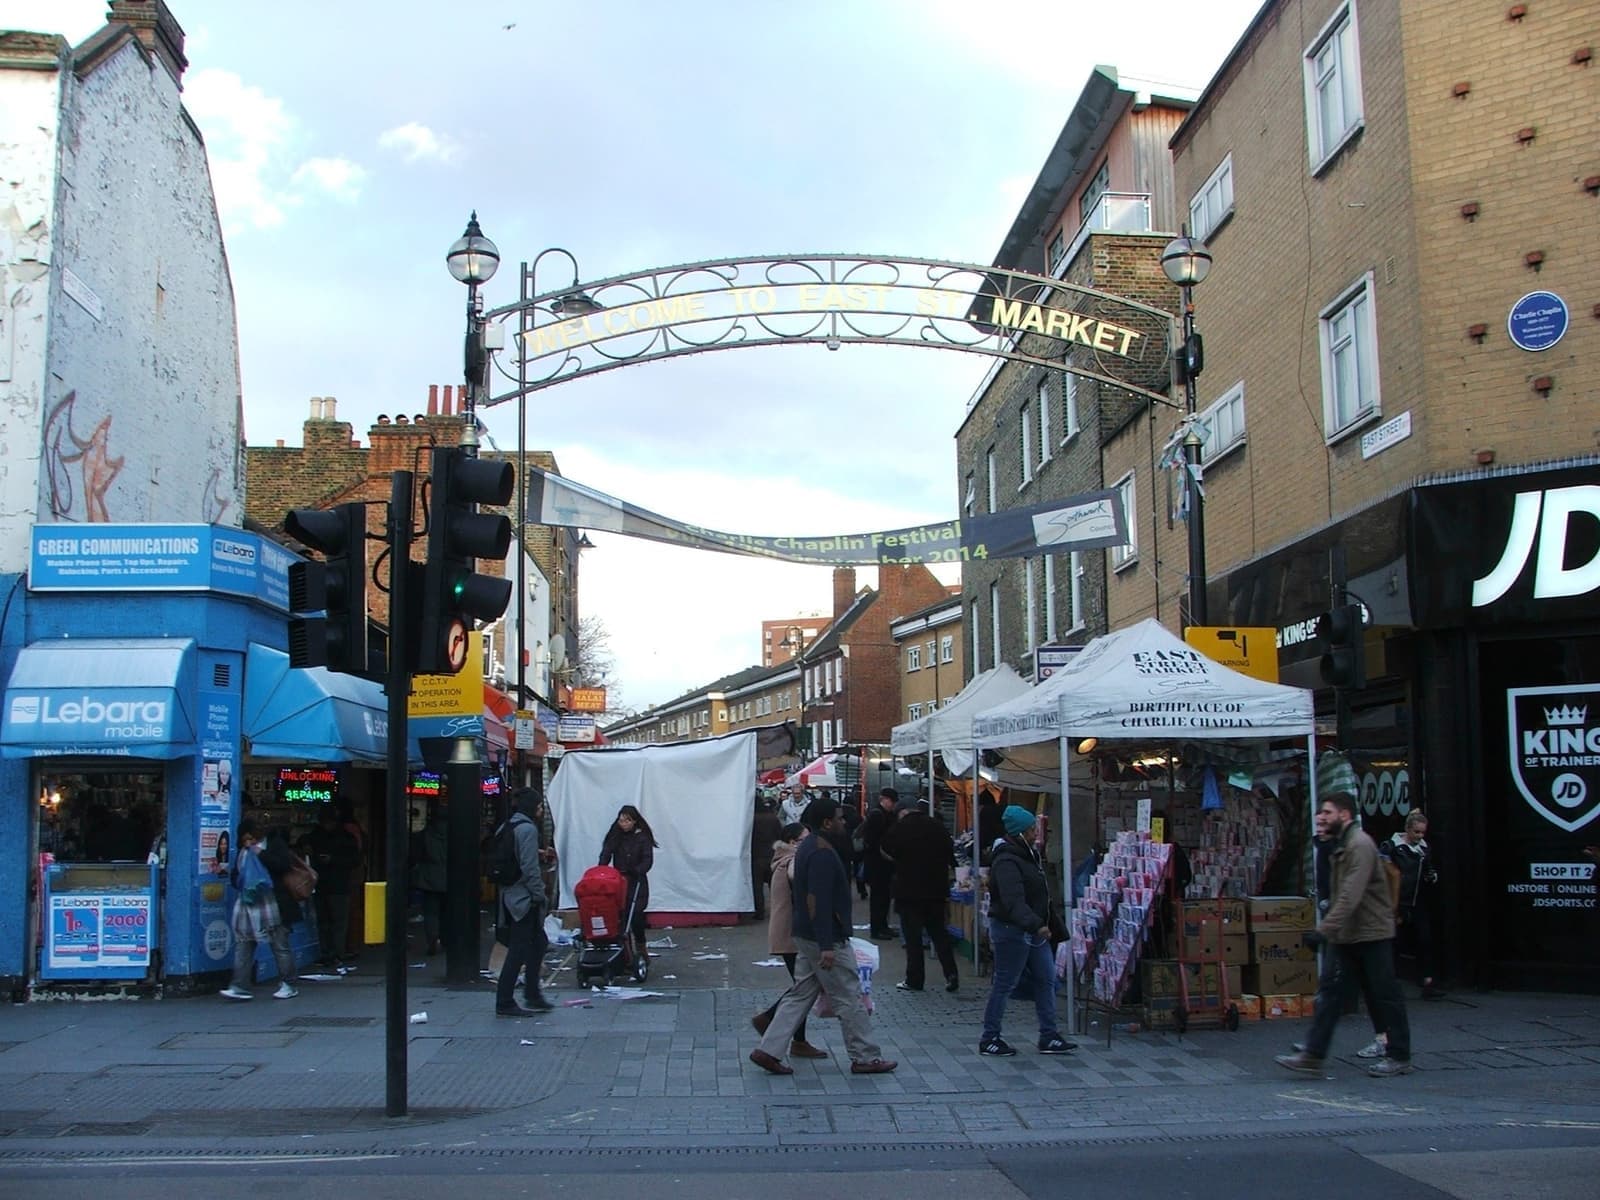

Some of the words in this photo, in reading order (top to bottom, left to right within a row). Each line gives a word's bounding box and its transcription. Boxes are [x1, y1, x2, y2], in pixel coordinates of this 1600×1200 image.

[522, 296, 705, 355] WELCOME
[730, 290, 777, 313] TO
[803, 285, 893, 311] EAST
[992, 297, 1140, 357] MARKET
[684, 525, 767, 546] Charlie
[774, 536, 864, 553] Chaplin
[871, 520, 962, 548] Festival
[38, 539, 78, 556] GREEN
[81, 538, 199, 556] COMMUNICATIONS
[223, 542, 254, 558] Lebara
[1472, 485, 1600, 607] JD
[932, 544, 988, 562] 2014
[1133, 650, 1201, 661] EAST
[1135, 661, 1208, 669] STREET
[419, 688, 461, 697] OPERATION
[42, 696, 166, 723] Lebara
[1129, 702, 1222, 713] BIRTHPLACE
[1225, 703, 1245, 713] OF
[1121, 717, 1188, 728] CHARLIE
[1192, 718, 1253, 728] CHAPLIN
[104, 724, 164, 738] mobile
[1525, 757, 1538, 767] OF
[281, 772, 335, 783] UNLOCKING
[303, 781, 311, 791] &
[1557, 782, 1582, 800] JD
[285, 790, 331, 800] REPAIRS
[1533, 866, 1567, 877] SHOP
[1570, 867, 1581, 877] IT
[1507, 884, 1550, 893] INSTORE
[1557, 884, 1597, 893] ONLINE
[63, 898, 99, 907] Lebara
[111, 898, 148, 907] Lebara
[104, 915, 146, 927] 2000
